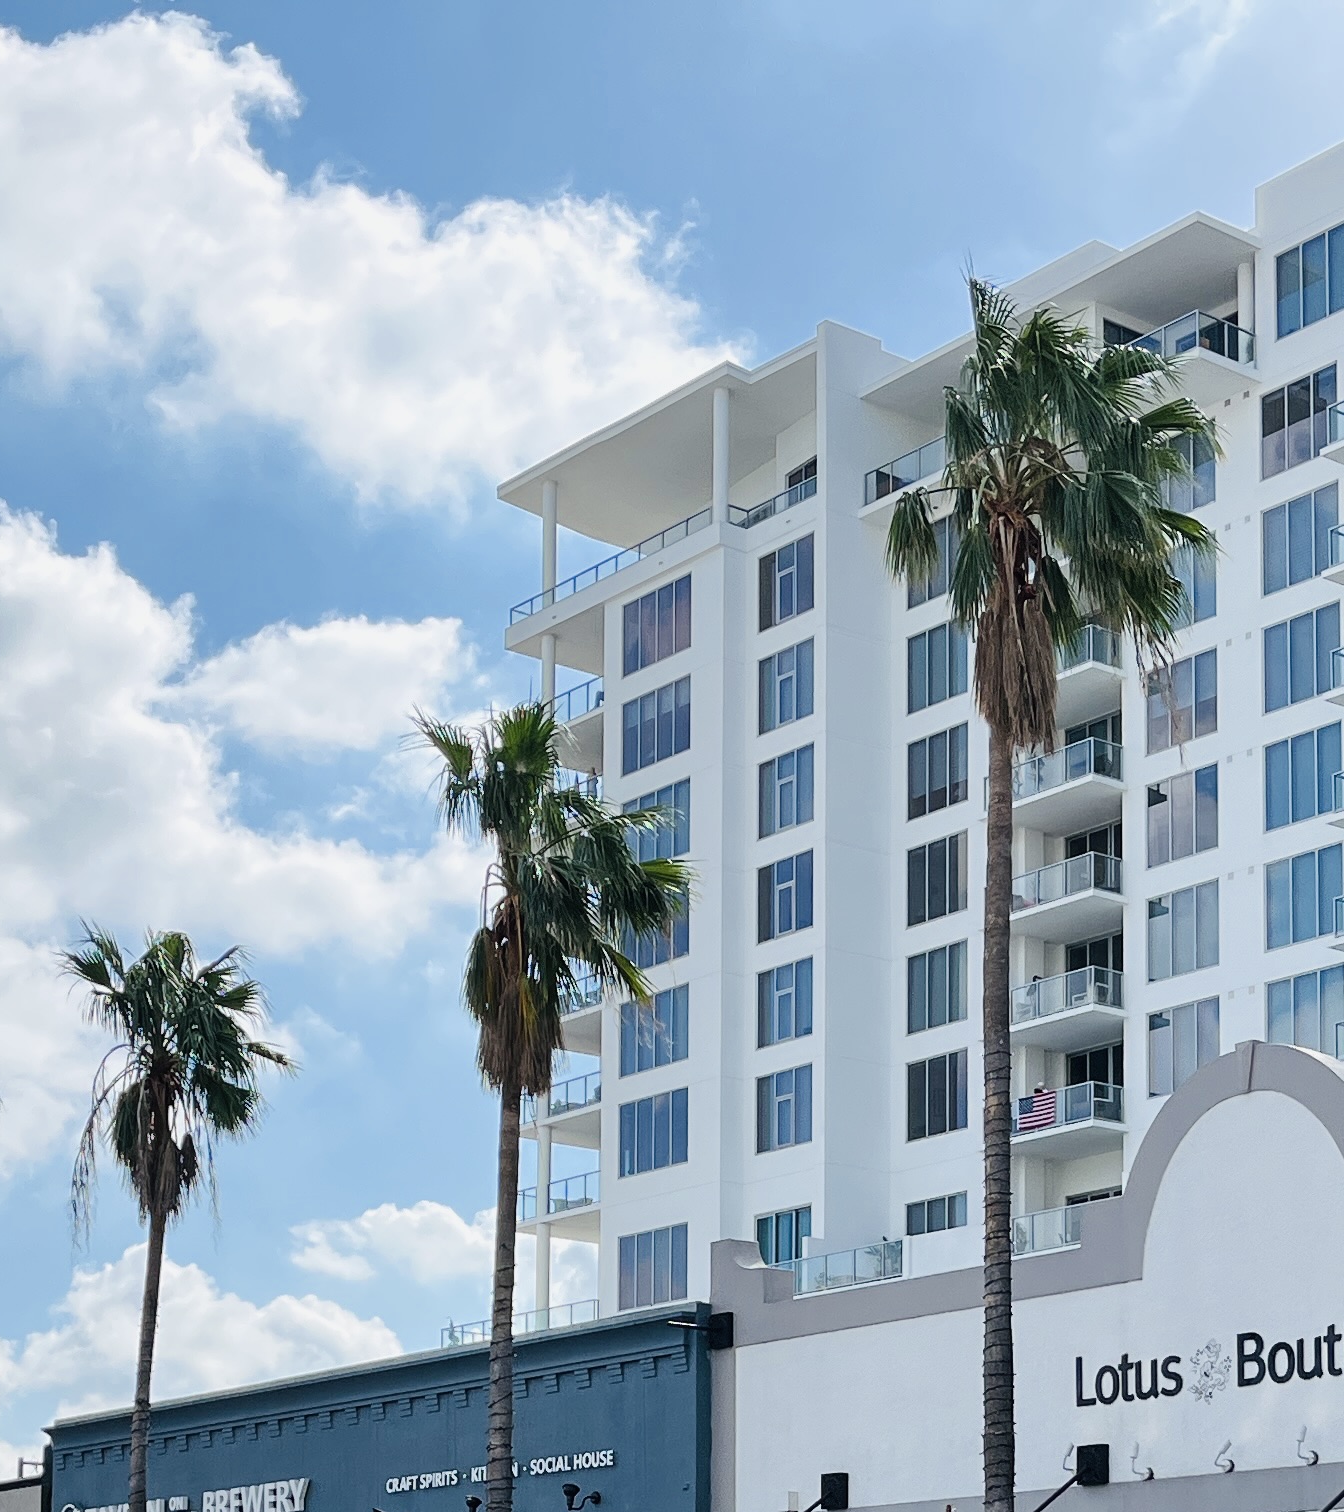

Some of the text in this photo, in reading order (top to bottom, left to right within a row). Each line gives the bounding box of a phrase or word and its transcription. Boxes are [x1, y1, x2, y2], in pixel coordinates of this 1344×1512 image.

[1076, 1353, 1183, 1407] Lotus
[386, 1449, 614, 1494] CRAFT SPIRITS KITN SOCIAL HOUSE
[168, 1497, 188, 1512] ON
